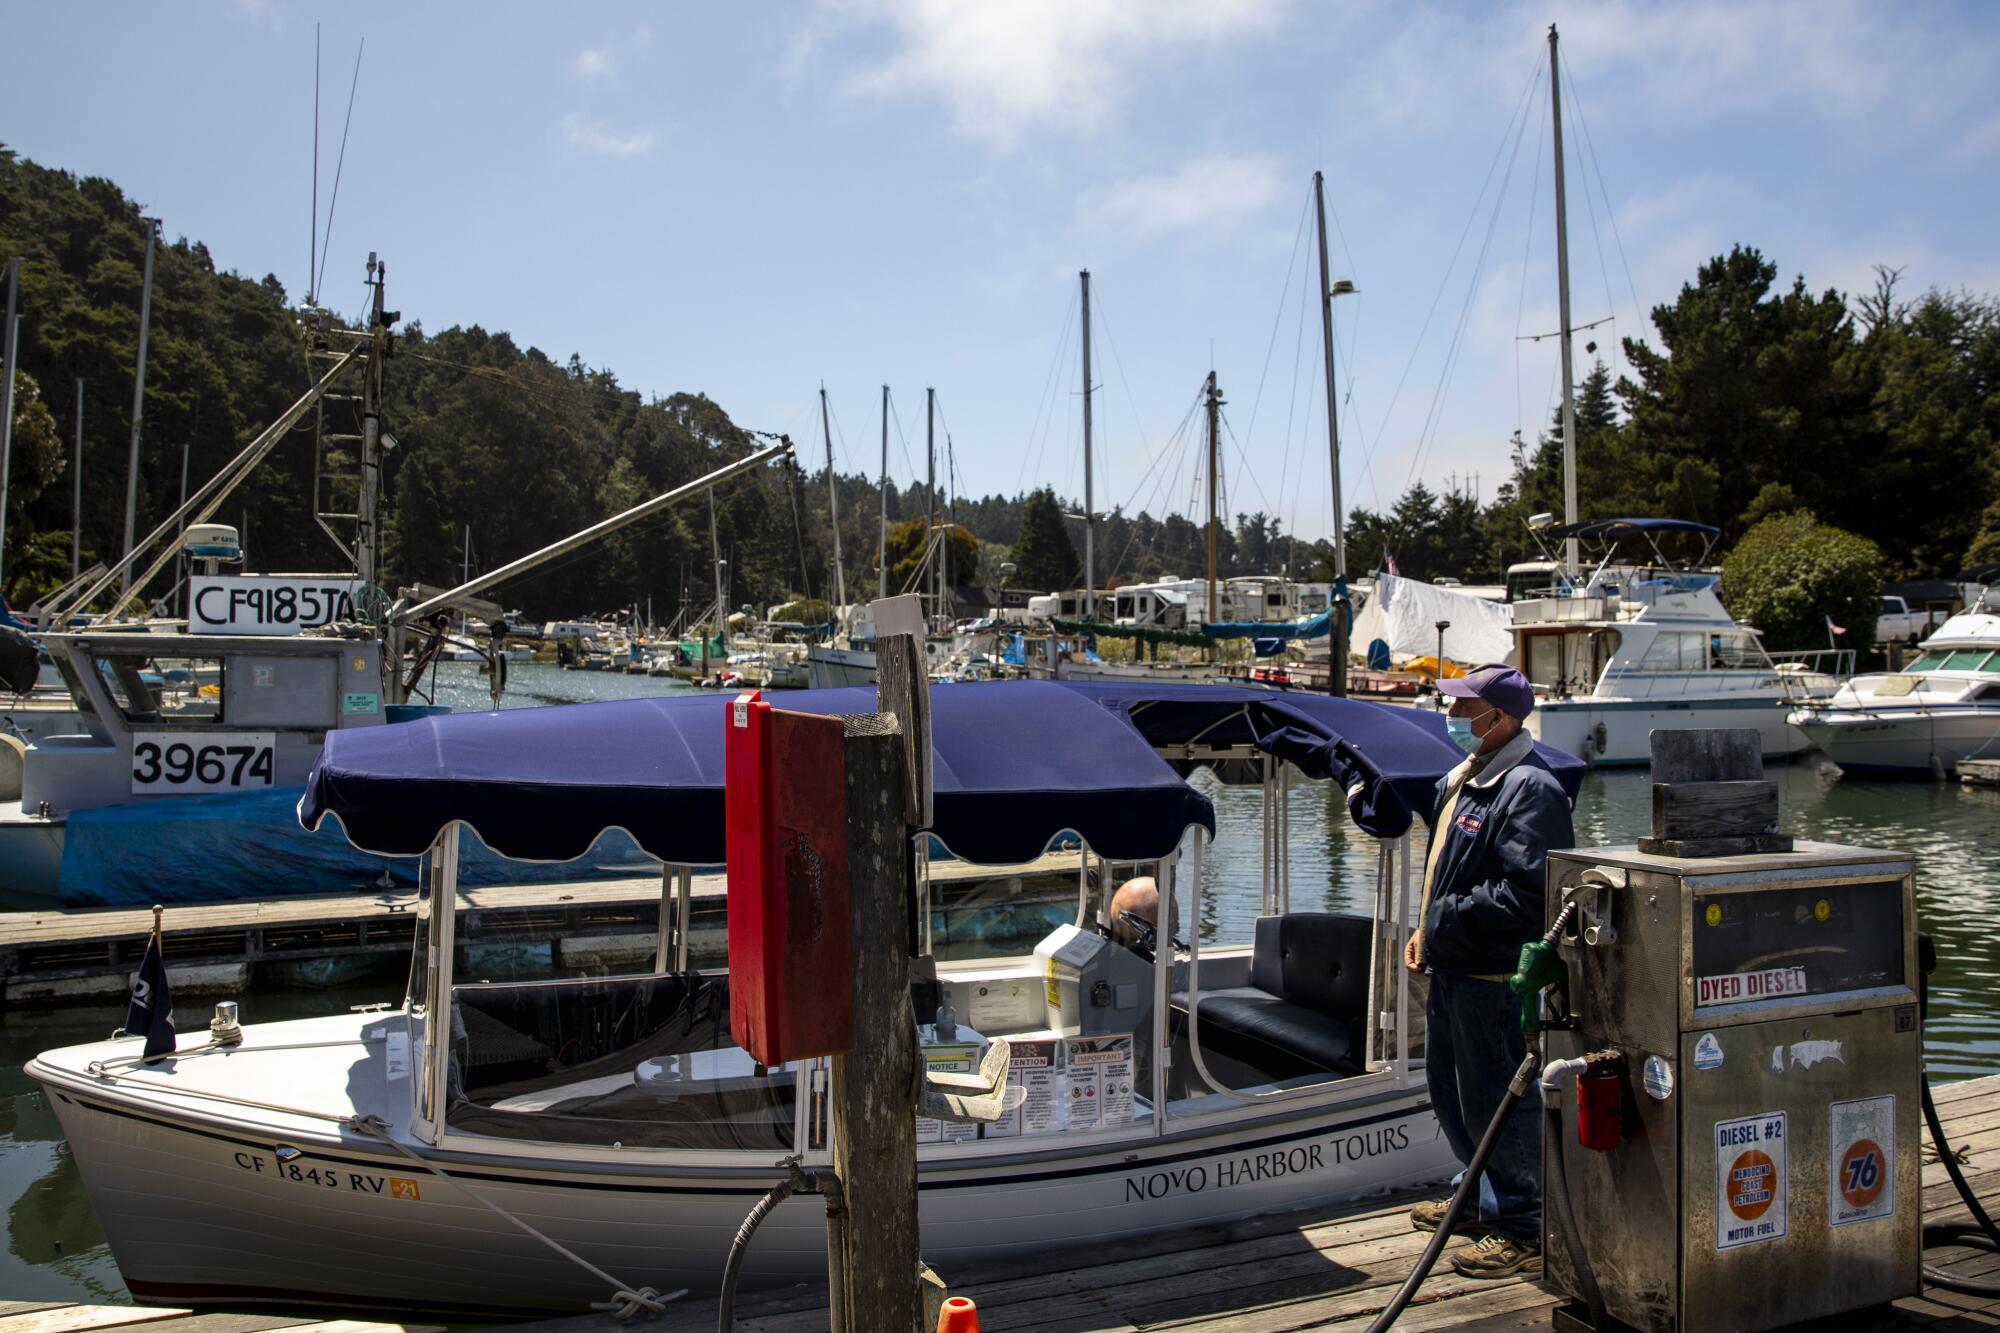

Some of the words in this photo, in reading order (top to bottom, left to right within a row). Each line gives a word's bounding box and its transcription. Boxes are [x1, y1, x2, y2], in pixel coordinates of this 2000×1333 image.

[133, 741, 273, 786] 39674
[1701, 977, 1740, 1001] DYED
[1747, 968, 1803, 995] DIESEL
[929, 1062, 959, 1072] NOTICE
[1010, 1056, 1047, 1067] TENTION
[1077, 1053, 1122, 1063] IMPORTANT
[1720, 1124, 1760, 1147] DIESEL
[1764, 1120, 1782, 1140] #2
[234, 1152, 264, 1172] CF
[277, 1160, 338, 1187] 1845
[349, 1173, 385, 1194] RV
[1125, 1166, 1207, 1202] NOVO
[1217, 1144, 1324, 1188] HARBOR
[1331, 1124, 1410, 1164] TOURS
[1846, 1152, 1878, 1191] 76
[400, 1182, 417, 1197] 21
[1728, 1225, 1755, 1241] MOTOR
[1757, 1221, 1776, 1235] FUEL
